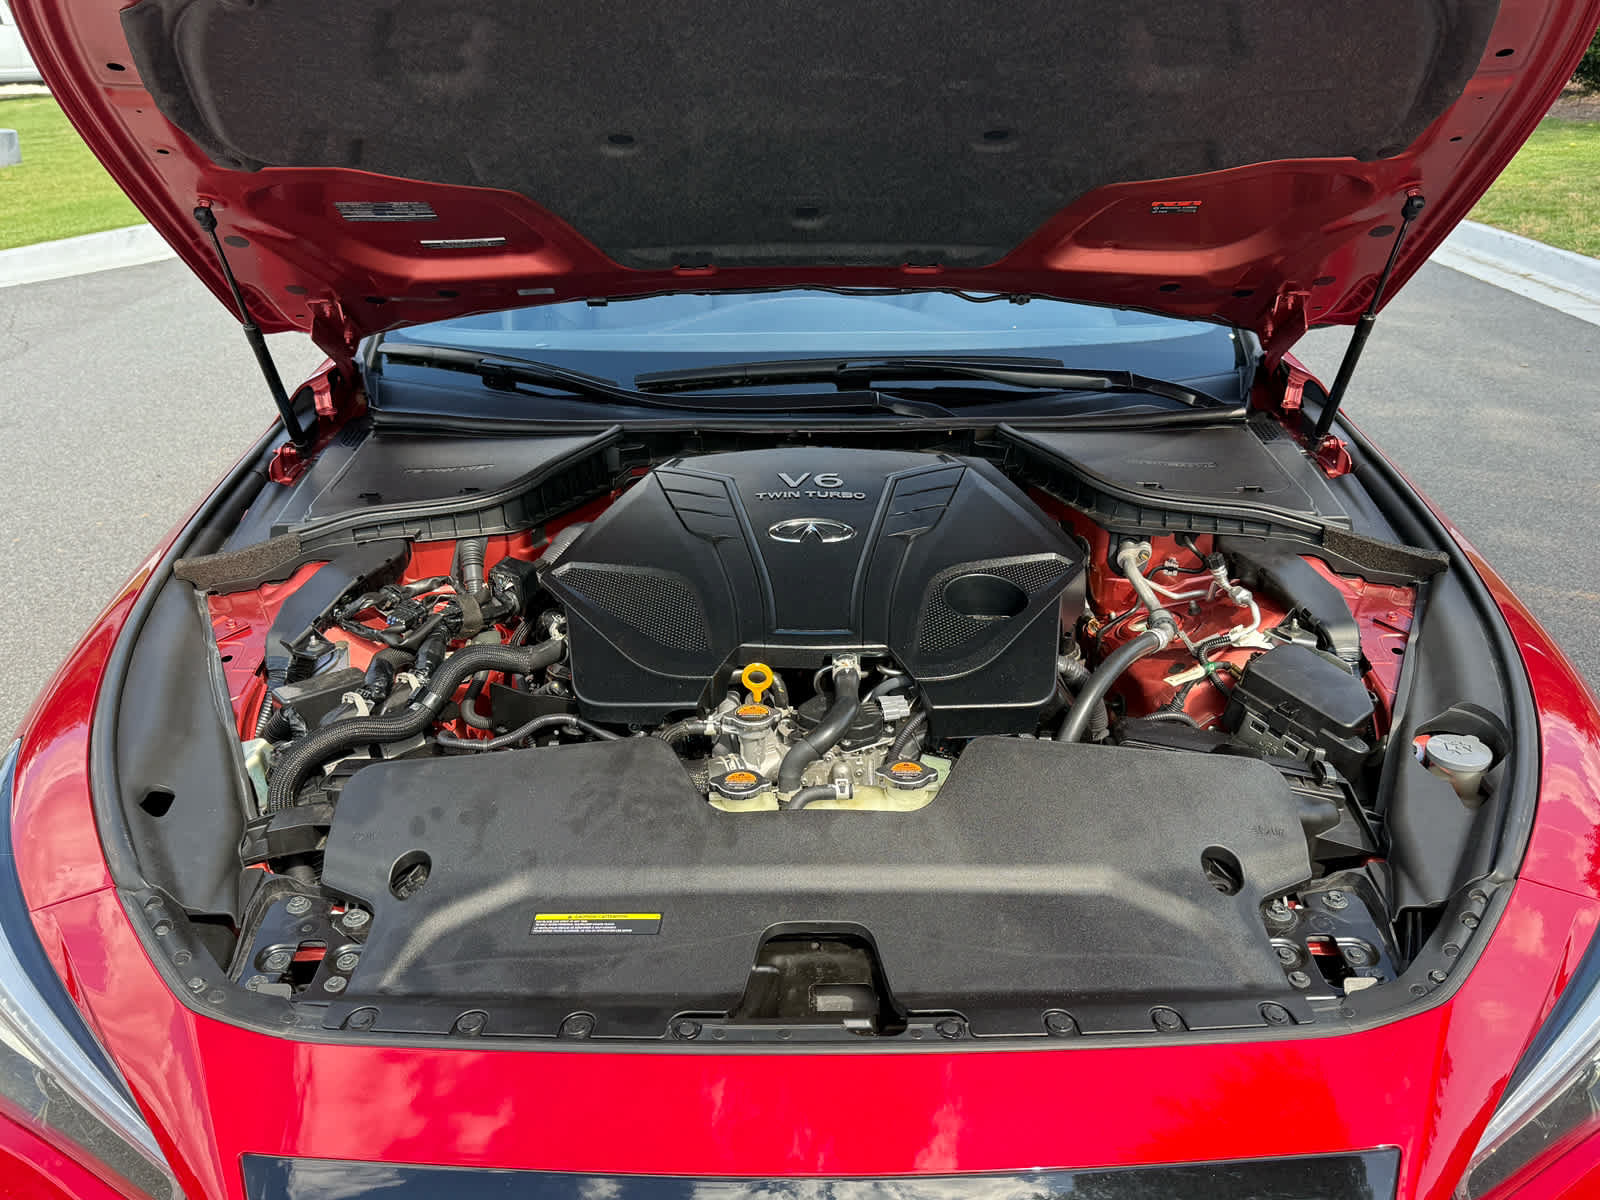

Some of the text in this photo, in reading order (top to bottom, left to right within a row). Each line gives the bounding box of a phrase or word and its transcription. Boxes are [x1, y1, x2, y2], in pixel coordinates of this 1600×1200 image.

[777, 472, 844, 488] V6
[755, 490, 866, 499] TWIN TURBO
